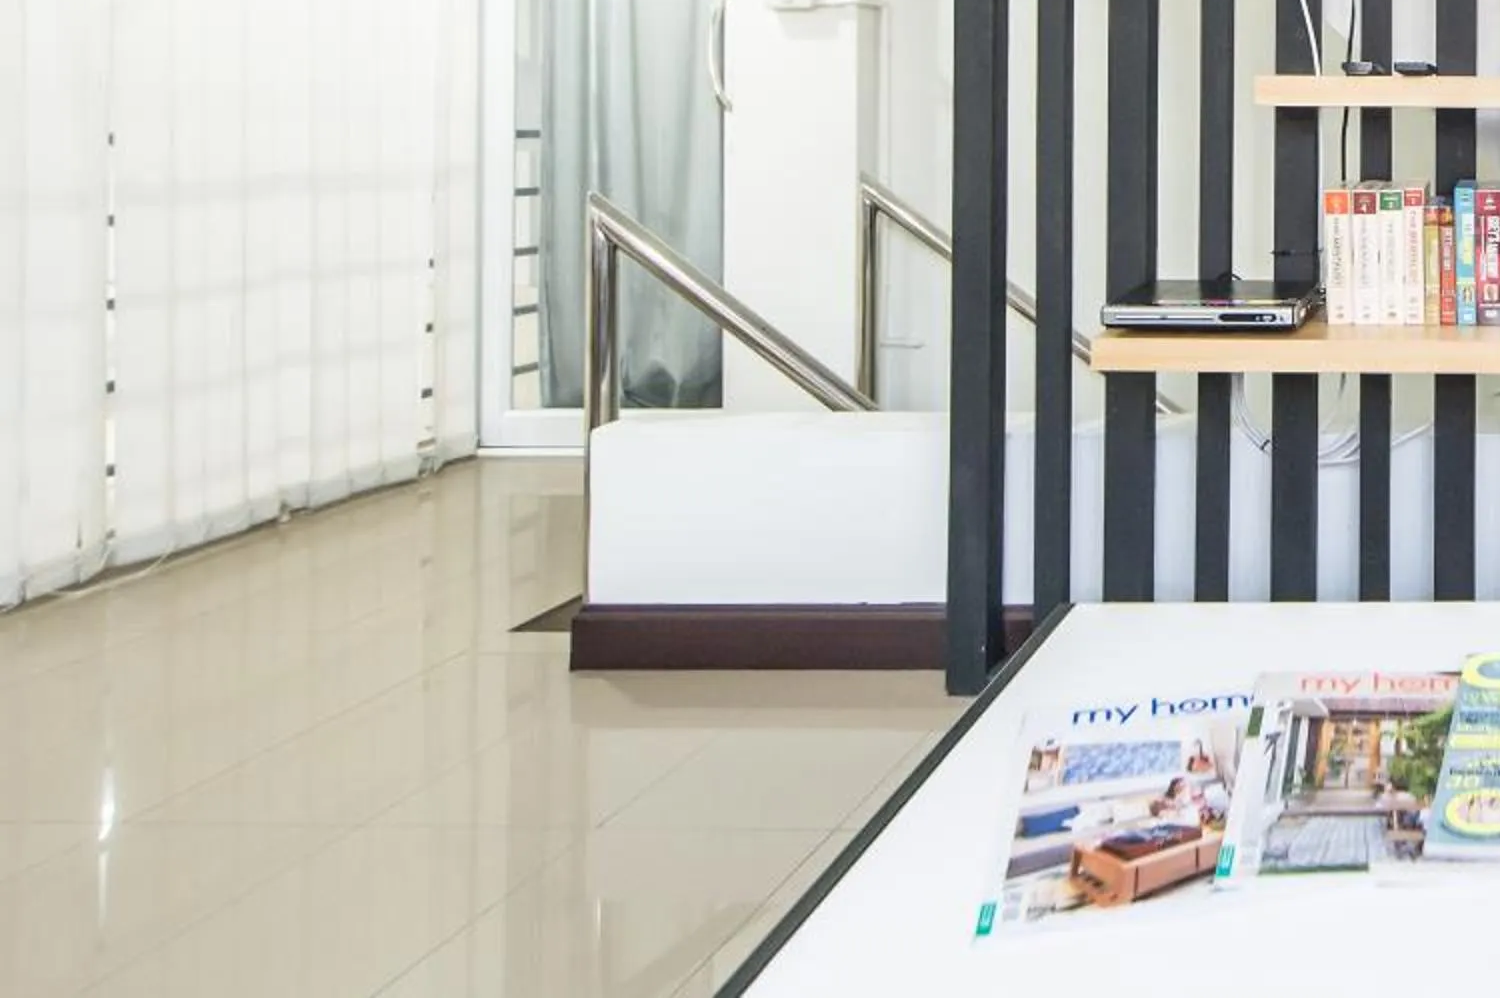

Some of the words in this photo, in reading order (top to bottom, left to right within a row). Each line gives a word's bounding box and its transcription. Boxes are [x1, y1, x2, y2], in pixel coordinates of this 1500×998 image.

[1299, 676, 1361, 694] my
[1372, 671, 1452, 691] hom
[1071, 703, 1138, 725] my
[1150, 692, 1256, 717] hom
